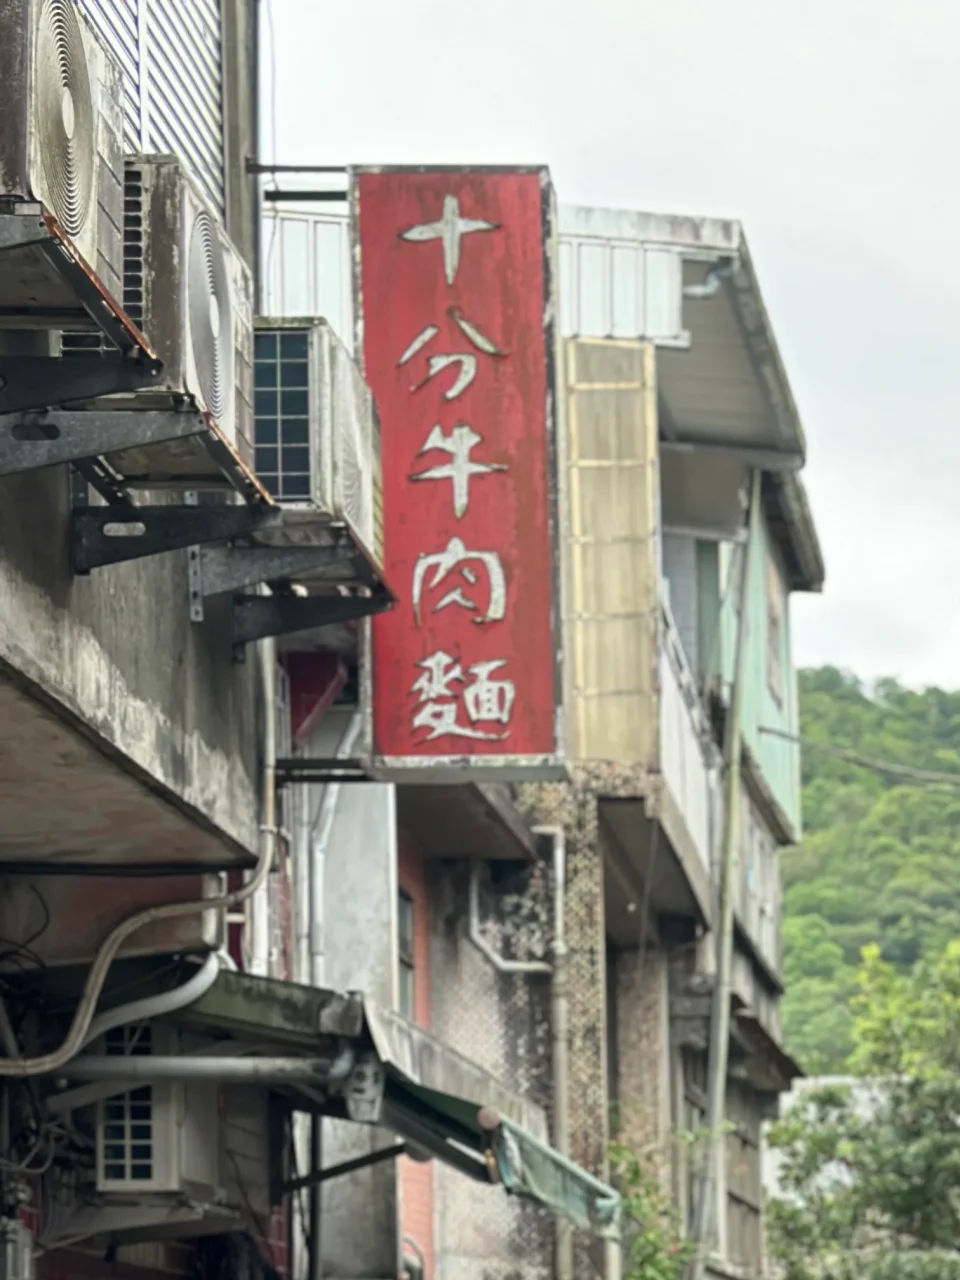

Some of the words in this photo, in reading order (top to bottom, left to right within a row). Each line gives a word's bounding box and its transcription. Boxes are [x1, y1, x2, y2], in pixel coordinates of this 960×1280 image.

[398, 195, 515, 745] 十分牛肉麵
